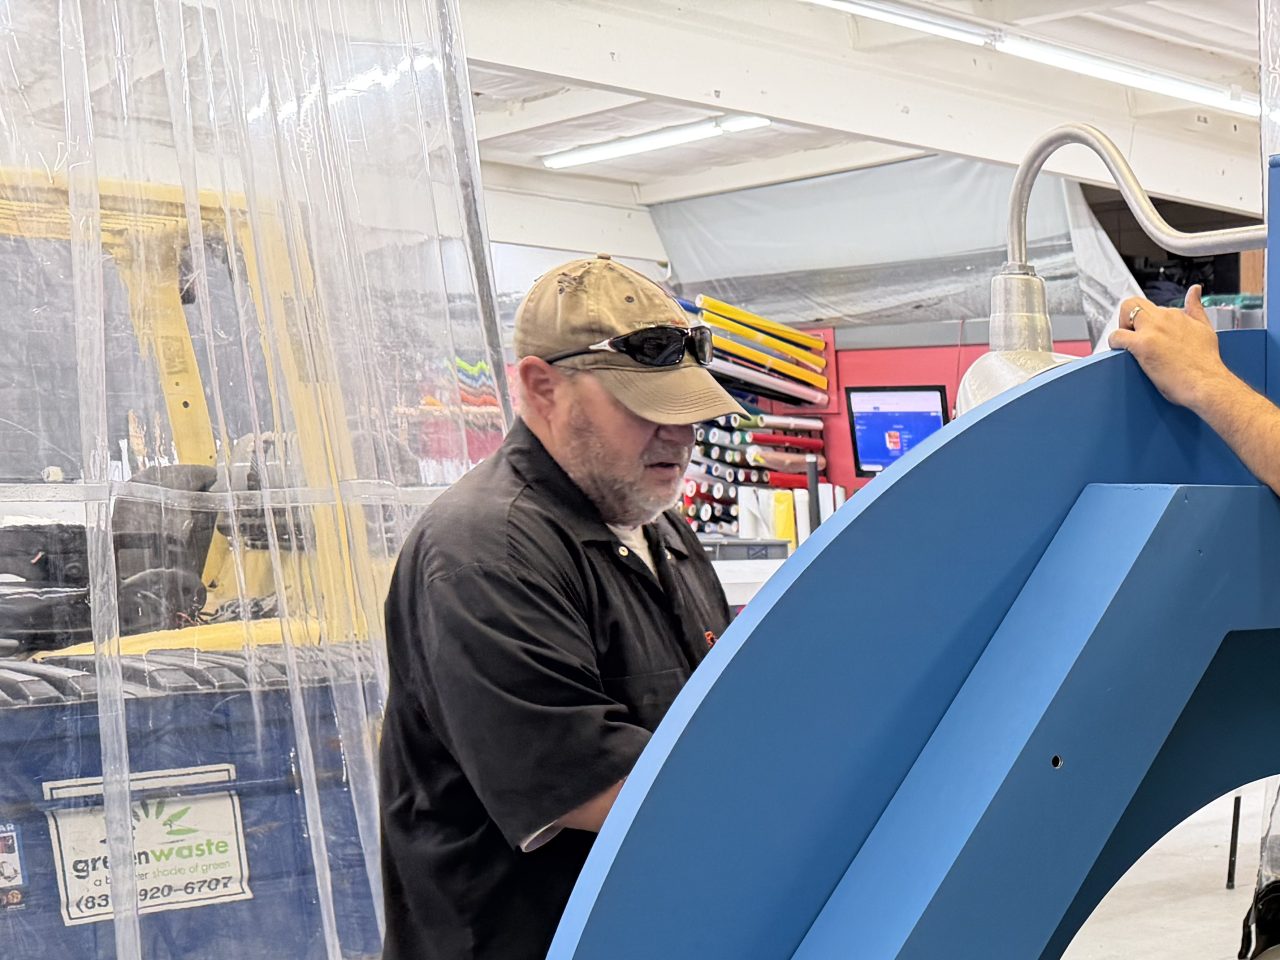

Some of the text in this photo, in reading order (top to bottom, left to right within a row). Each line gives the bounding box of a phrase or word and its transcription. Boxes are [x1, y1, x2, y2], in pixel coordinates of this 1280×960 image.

[72, 838, 229, 879] grenwaste
[152, 865, 186, 879] shade
[188, 863, 199, 875] of
[200, 860, 231, 875] green
[75, 894, 110, 913] (83
[138, 876, 233, 901] 920-6707
